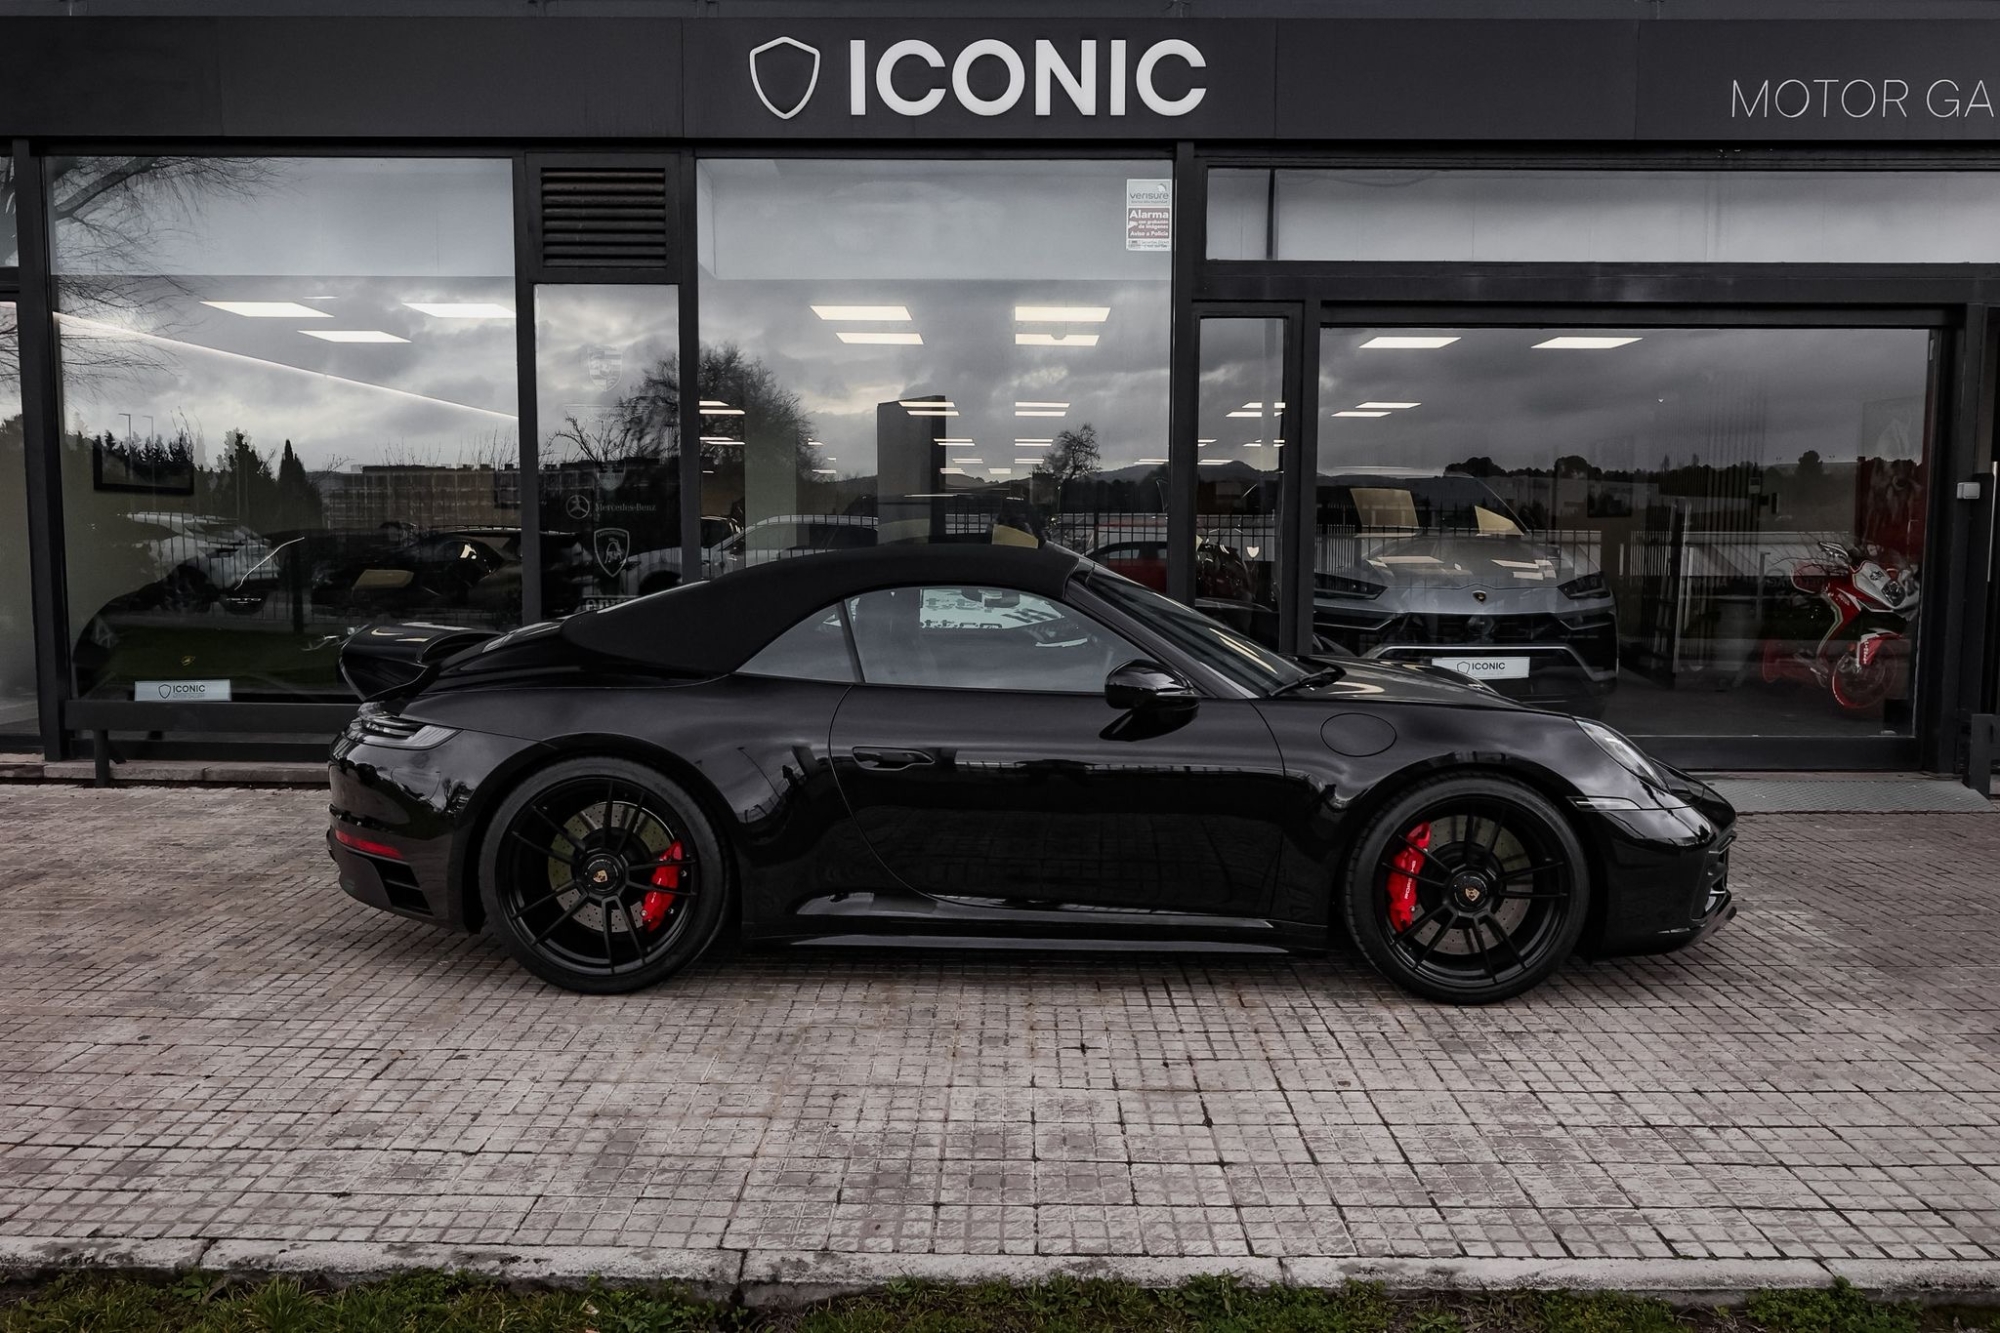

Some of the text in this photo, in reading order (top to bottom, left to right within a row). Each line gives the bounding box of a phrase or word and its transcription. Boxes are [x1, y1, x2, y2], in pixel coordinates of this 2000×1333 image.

[850, 38, 1207, 116] ICONIC
[1731, 79, 1995, 118] MOTOR GA
[1129, 209, 1169, 219] Alarma
[595, 503, 656, 511] Mercedes-Benz
[1472, 662, 1505, 670] ICONIC
[173, 685, 205, 693] ICONIC
